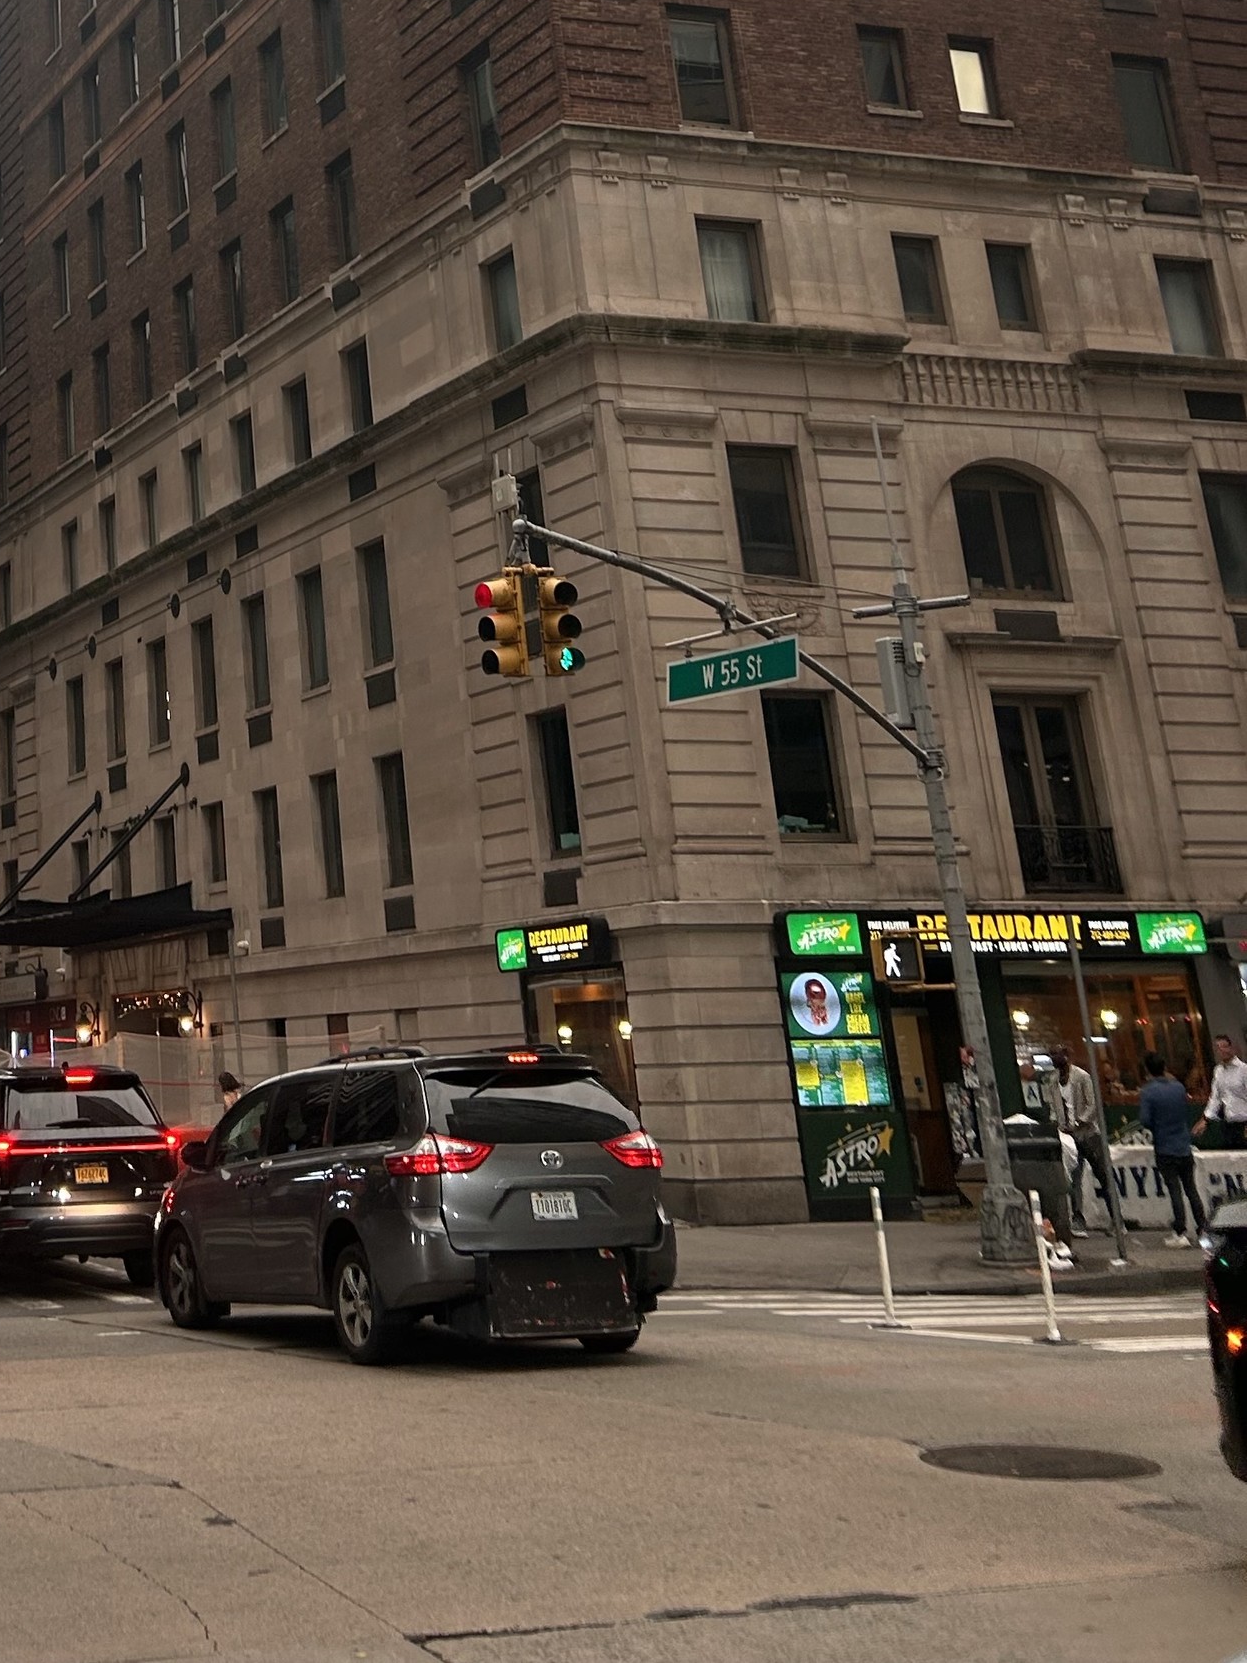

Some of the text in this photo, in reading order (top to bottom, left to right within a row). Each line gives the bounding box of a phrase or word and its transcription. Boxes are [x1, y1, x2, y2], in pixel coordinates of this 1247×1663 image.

[702, 654, 762, 689] W 55 St
[528, 924, 589, 947] RESTAURANT
[797, 925, 840, 951] ASTRO
[916, 915, 1082, 940] RETAURANT
[1027, 1085, 1038, 1100] A
[818, 1136, 879, 1188] ASTRO
